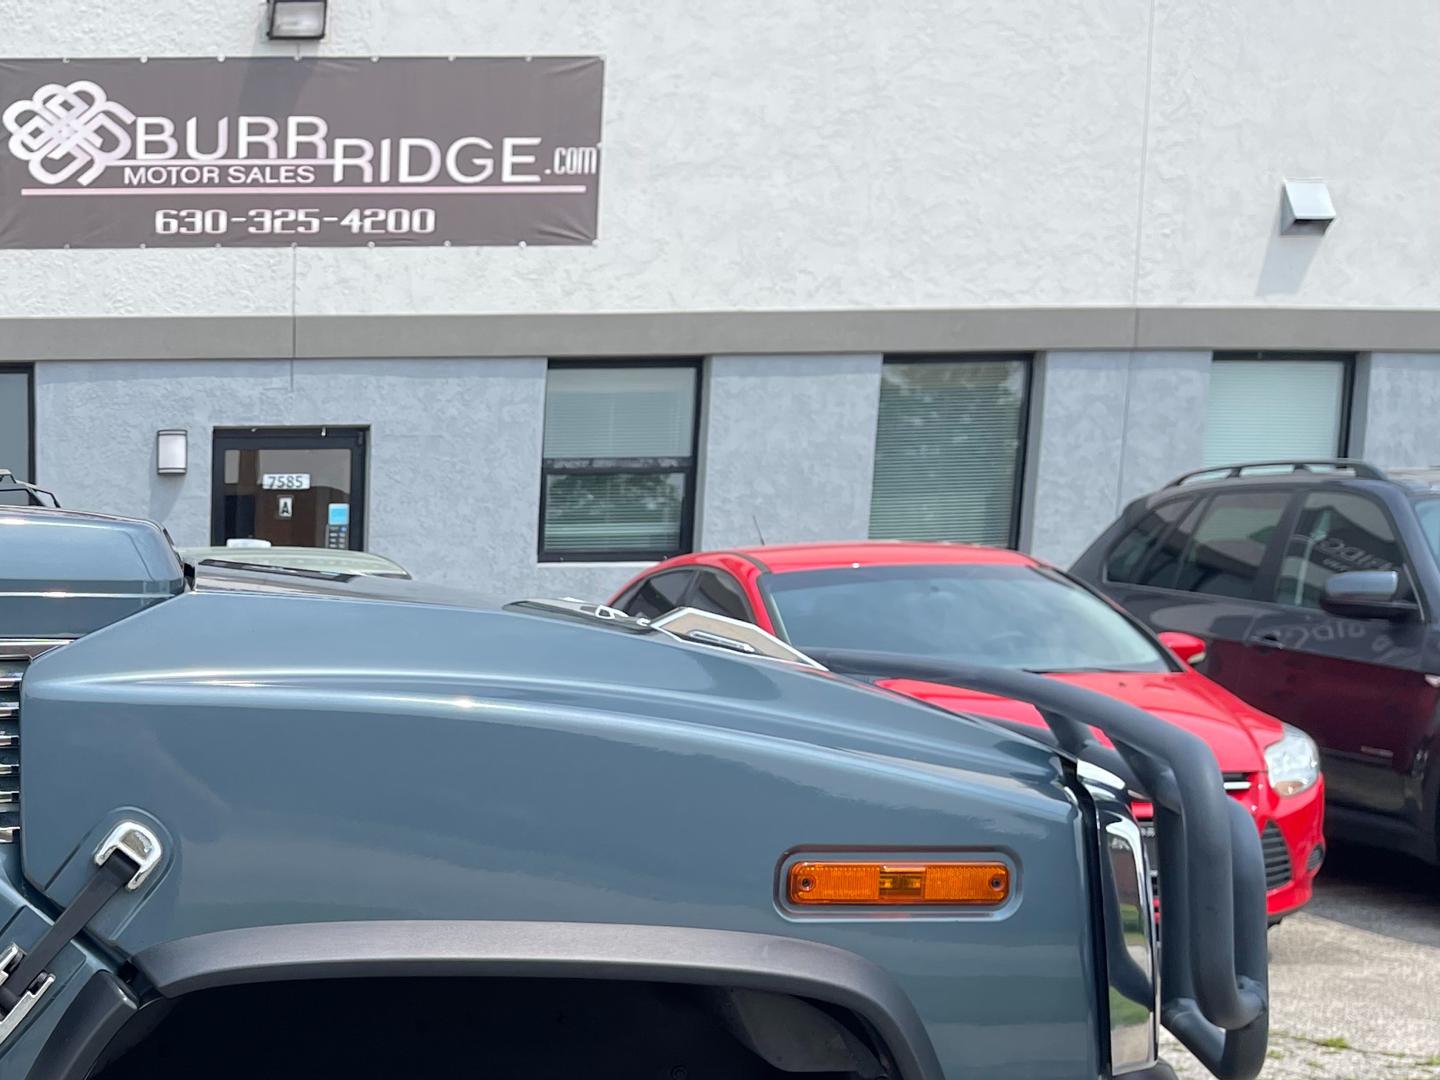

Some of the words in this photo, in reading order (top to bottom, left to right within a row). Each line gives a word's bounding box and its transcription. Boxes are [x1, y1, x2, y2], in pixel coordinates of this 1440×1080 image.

[135, 115, 329, 161] BURR
[332, 136, 542, 184] RIDGE
[123, 166, 220, 185] MOTOR
[227, 165, 316, 184] SALES
[154, 208, 436, 235] 630-325-4200
[267, 475, 304, 489] 7585
[281, 500, 290, 514] A
